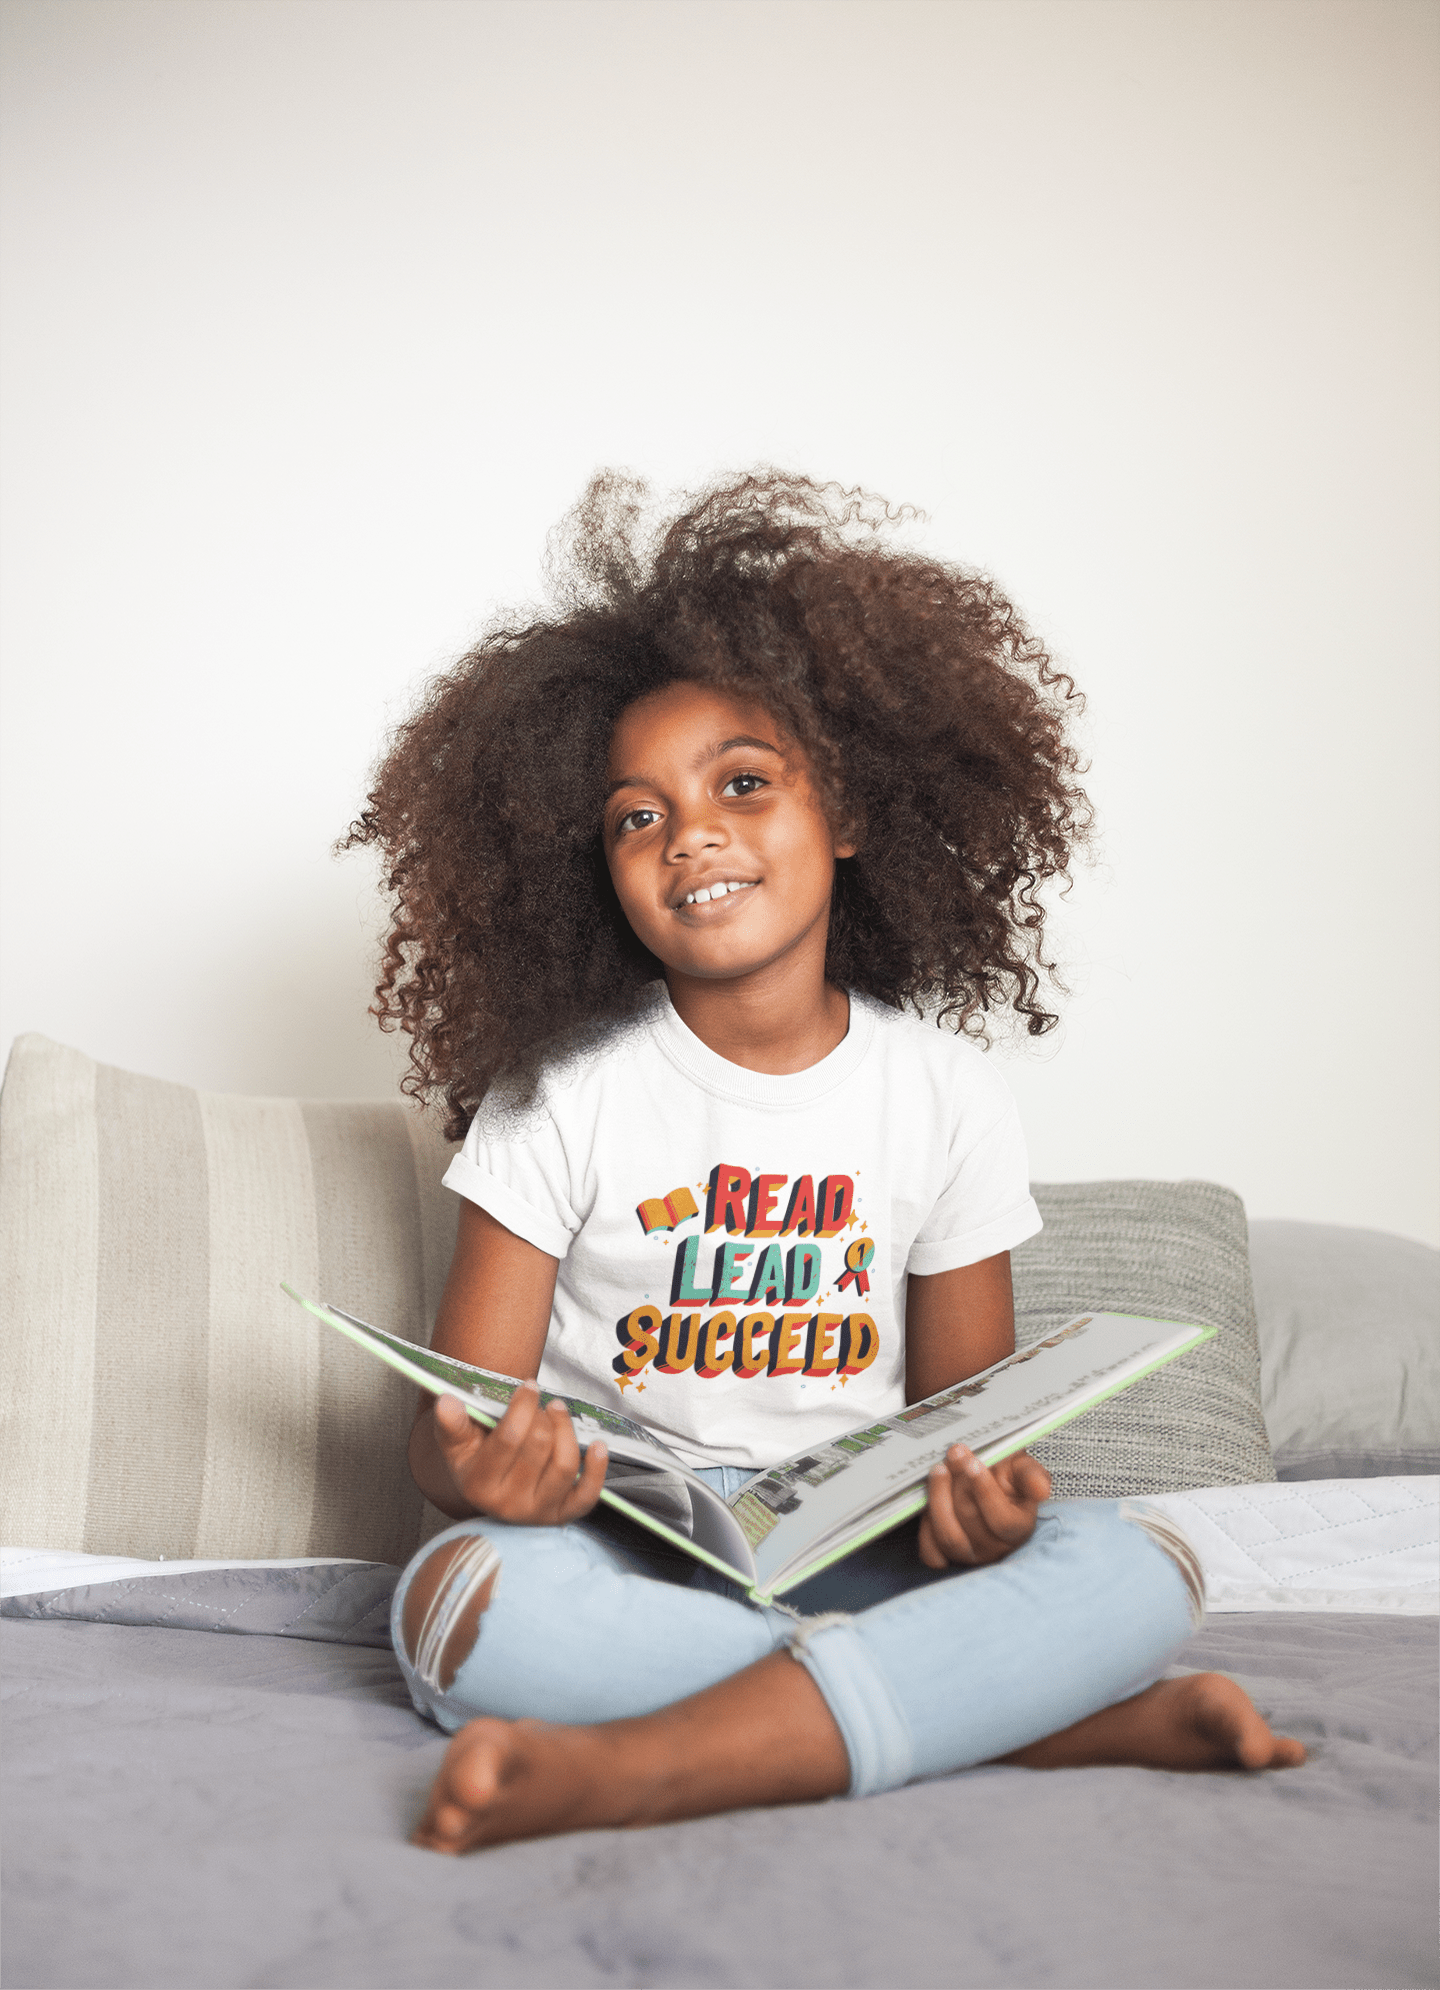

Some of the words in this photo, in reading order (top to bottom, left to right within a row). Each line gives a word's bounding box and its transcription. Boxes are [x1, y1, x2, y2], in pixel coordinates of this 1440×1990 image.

[704, 1163, 854, 1238] READ
[669, 1235, 822, 1307] LEAD
[612, 1305, 880, 1379] SUCCEED
